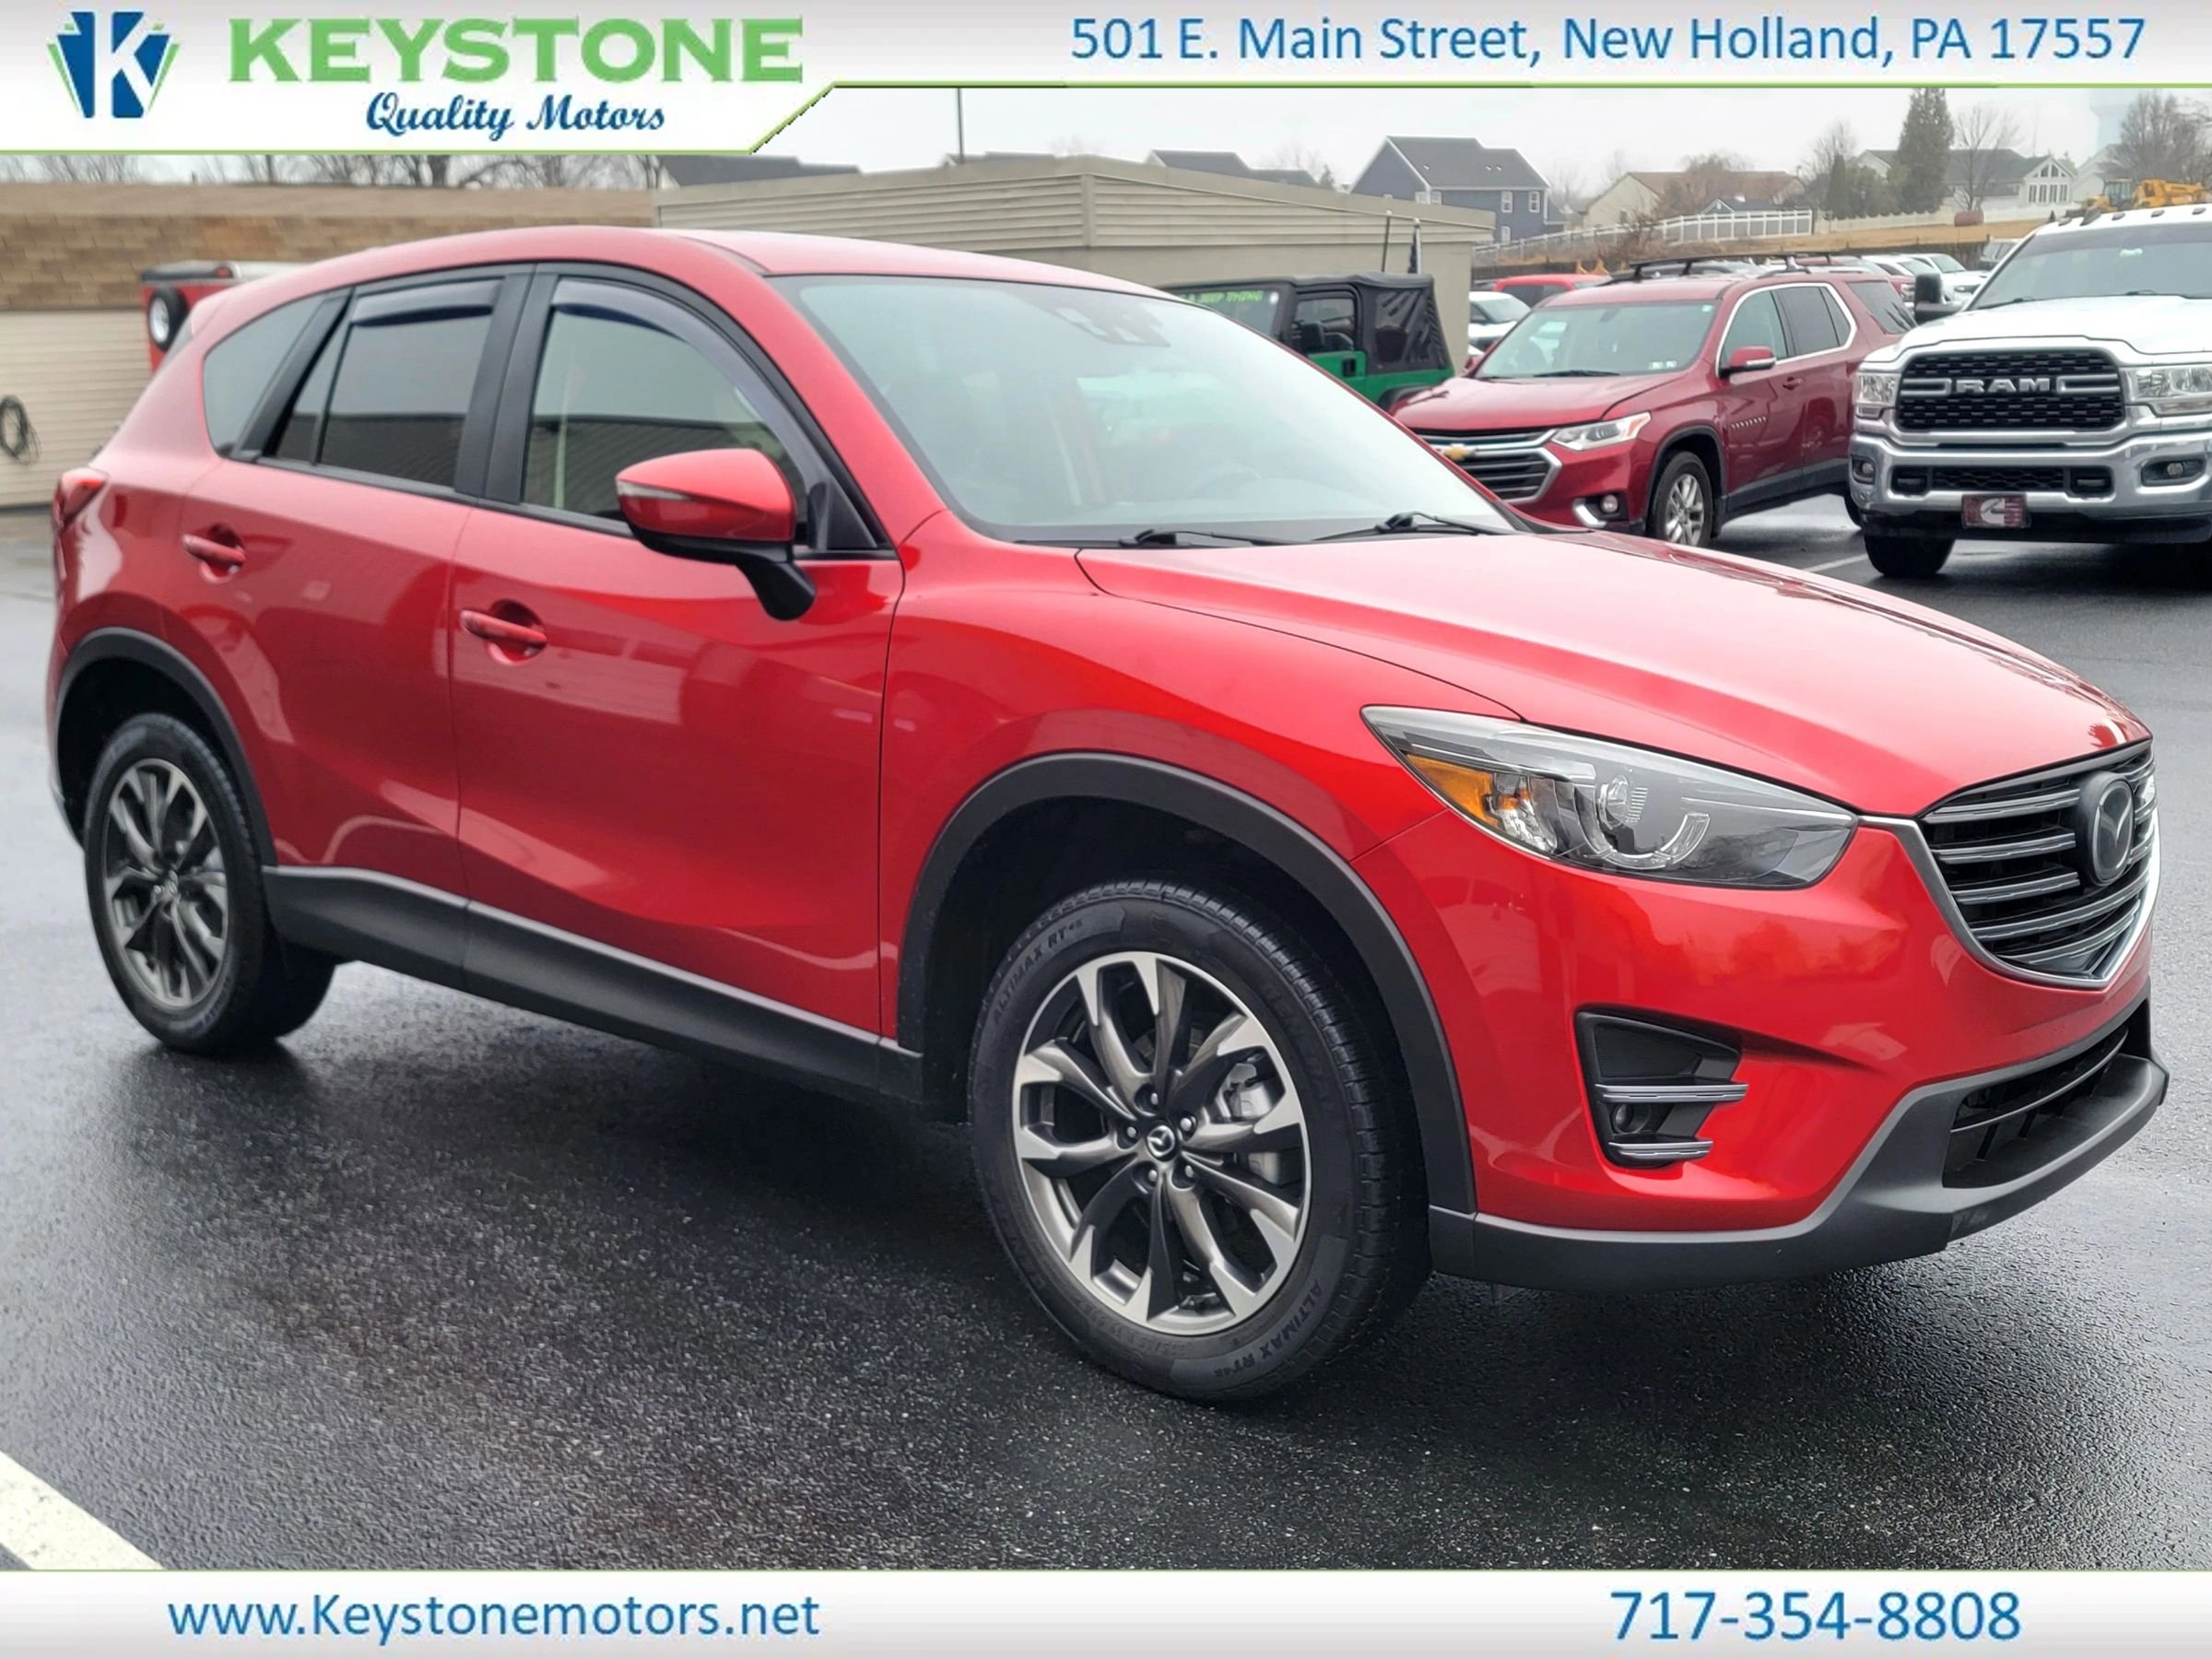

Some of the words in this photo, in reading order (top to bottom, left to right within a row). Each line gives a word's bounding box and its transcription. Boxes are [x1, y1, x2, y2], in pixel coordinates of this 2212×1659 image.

[1956, 378, 2051, 394] RAM
[994, 943, 1043, 1025] ALTIMAX
[1259, 1278, 1323, 1359] ALTIMAX
